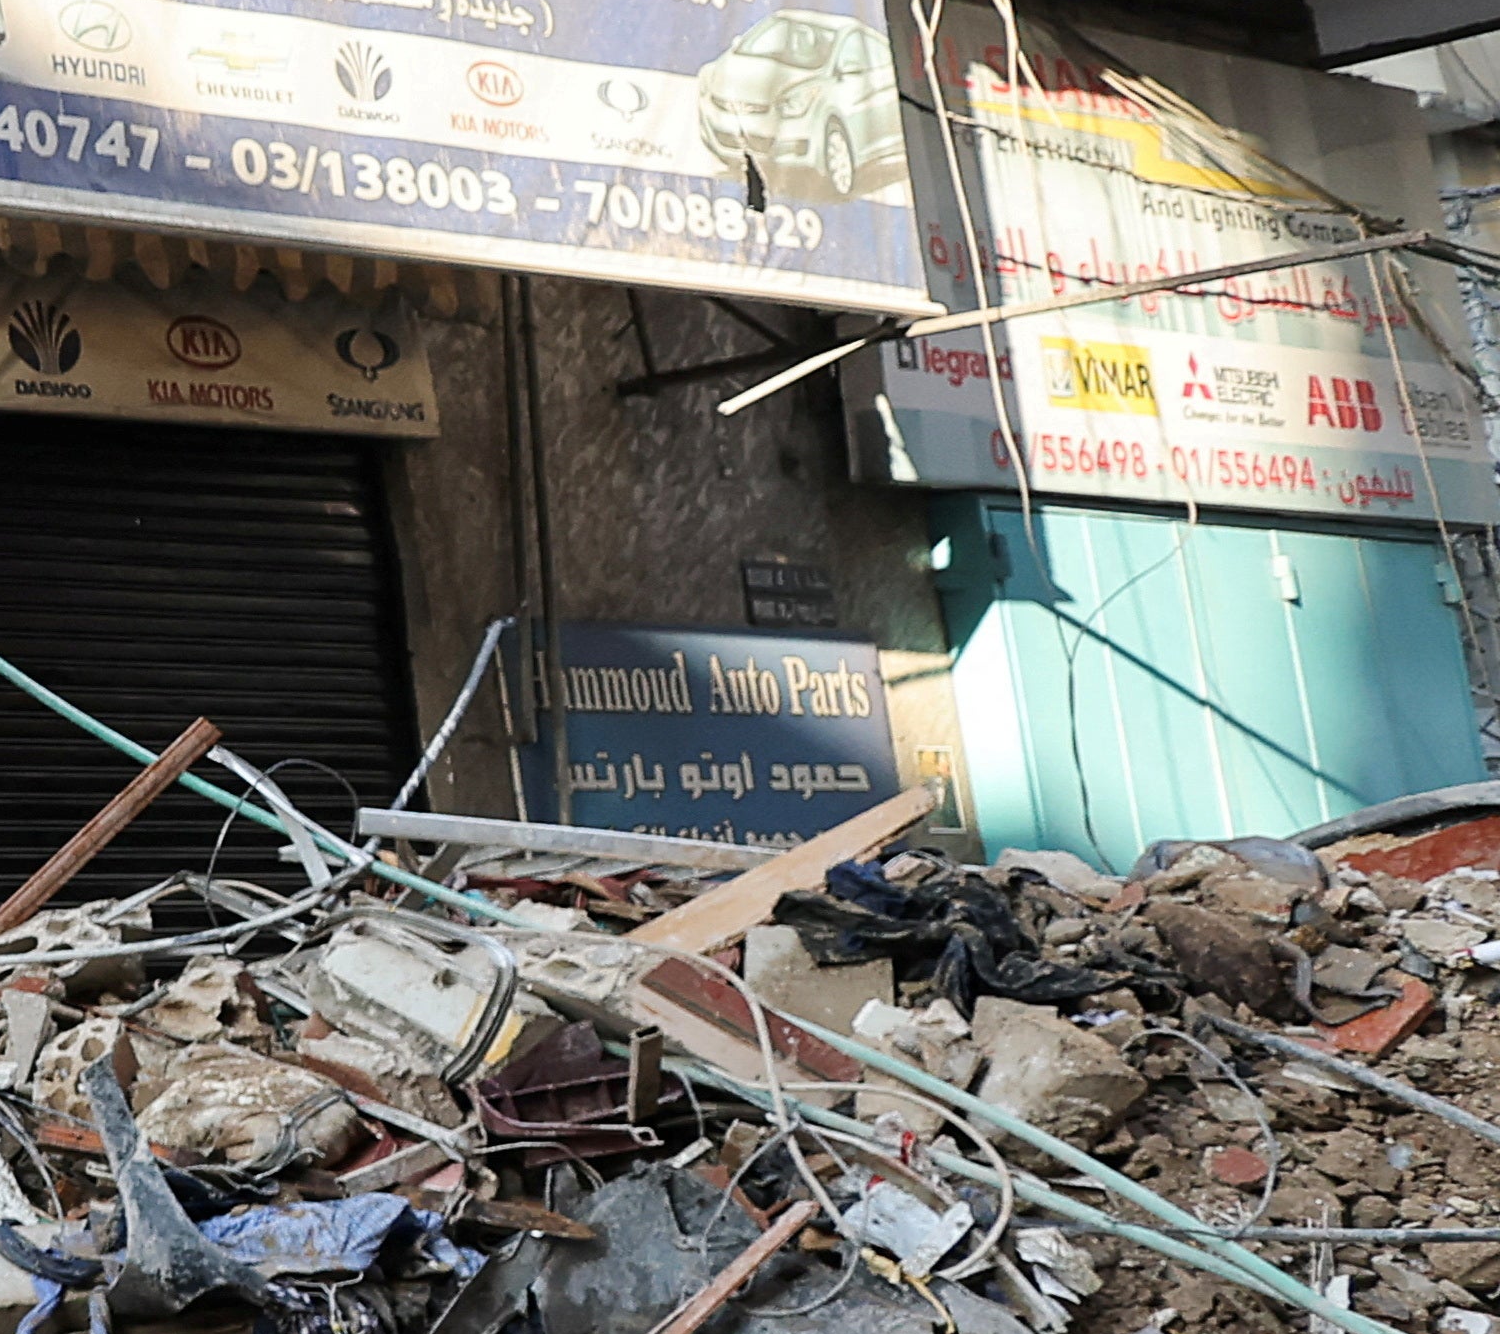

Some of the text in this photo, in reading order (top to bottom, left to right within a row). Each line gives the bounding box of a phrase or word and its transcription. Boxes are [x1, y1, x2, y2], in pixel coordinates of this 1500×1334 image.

[51, 53, 147, 87] HYUNDAI
[478, 71, 516, 99] KIA
[196, 80, 296, 106] CHEVROLET
[450, 113, 550, 144] KIA MOTORS
[231, 136, 518, 217] 03/138003
[181, 327, 231, 358] KIA
[920, 339, 1014, 387] legrad
[15, 379, 92, 400] DAEWOO
[146, 378, 274, 411] KIA MOTORS
[1308, 375, 1384, 433] ABB
[990, 428, 1149, 479] 0/556498
[1171, 445, 1318, 491] 01/556494
[532, 649, 872, 719] Hmmoud Auto Parts
[680, 750, 755, 801] اوتو
[770, 760, 871, 801] حمود
